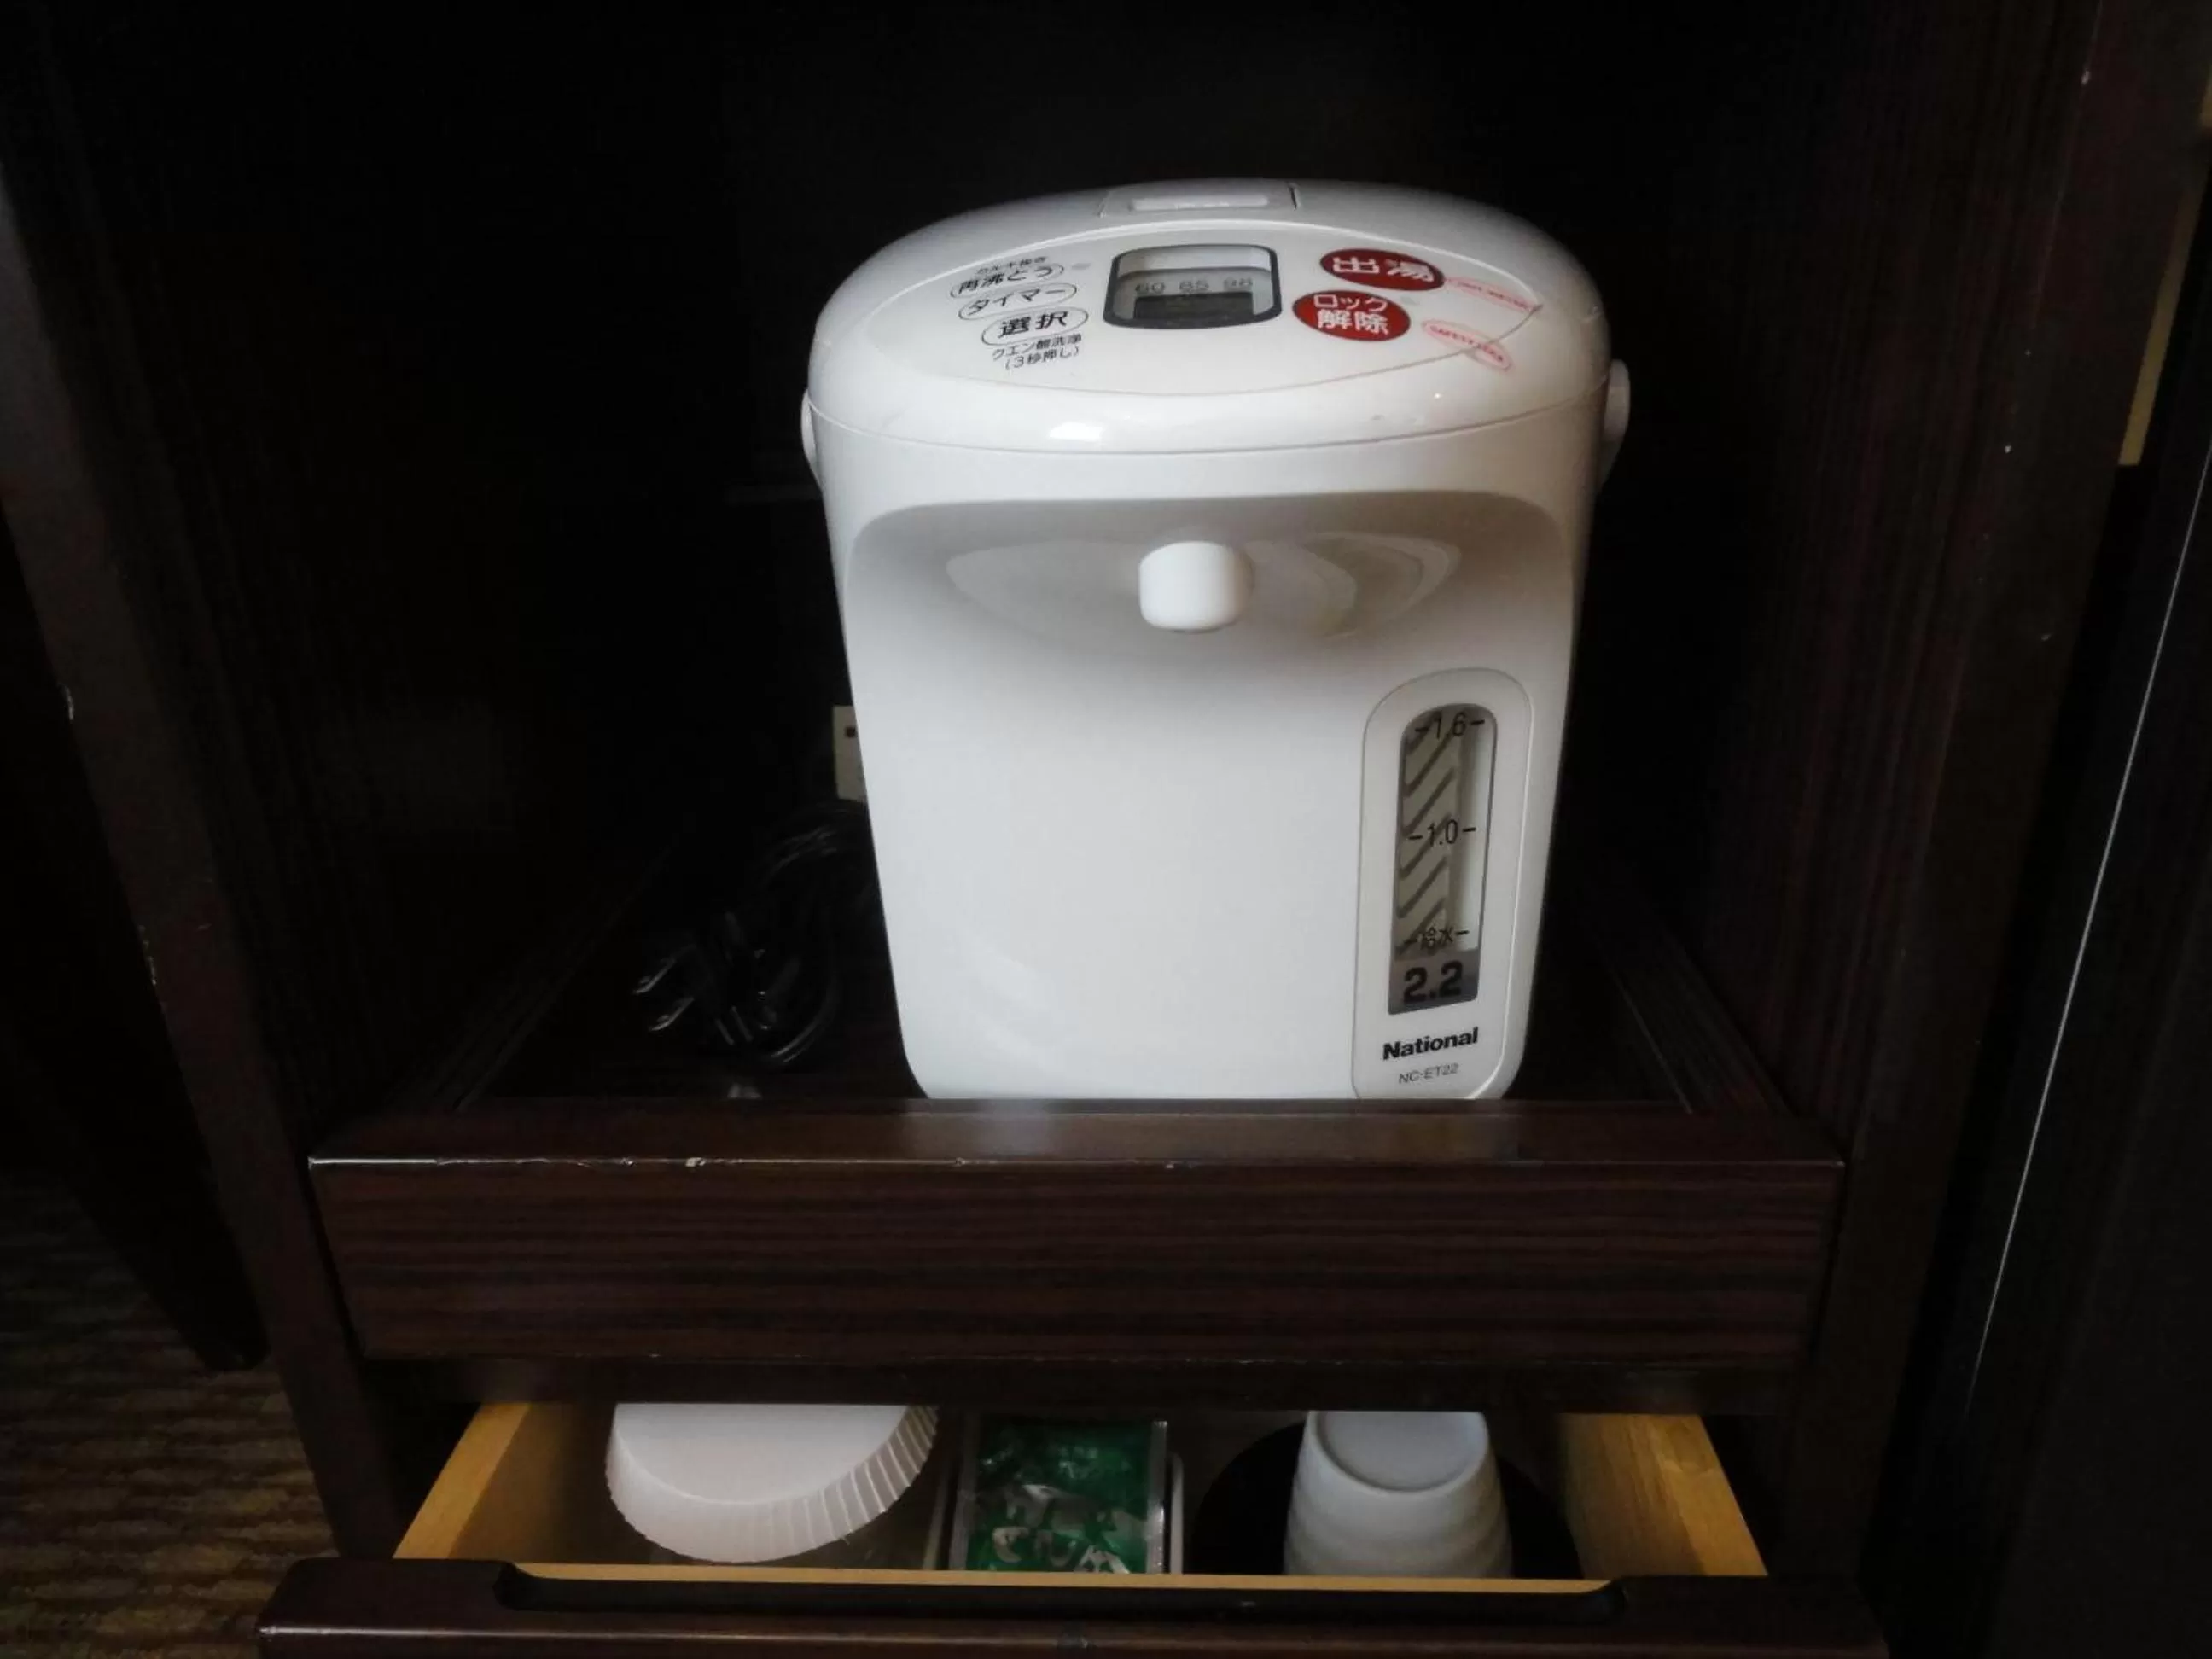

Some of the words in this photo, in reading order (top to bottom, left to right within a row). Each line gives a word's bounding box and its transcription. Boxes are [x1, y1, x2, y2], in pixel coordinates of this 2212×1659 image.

[1332, 256, 1435, 283] 出湯
[968, 288, 1067, 317] タイマー
[1313, 294, 1388, 312] ロック
[998, 311, 1068, 339] 選択
[1317, 308, 1390, 335] 解除
[1403, 960, 1464, 1004] 2.2
[1382, 1026, 1479, 1061] National
[1398, 1062, 1460, 1085] NC-ET22
